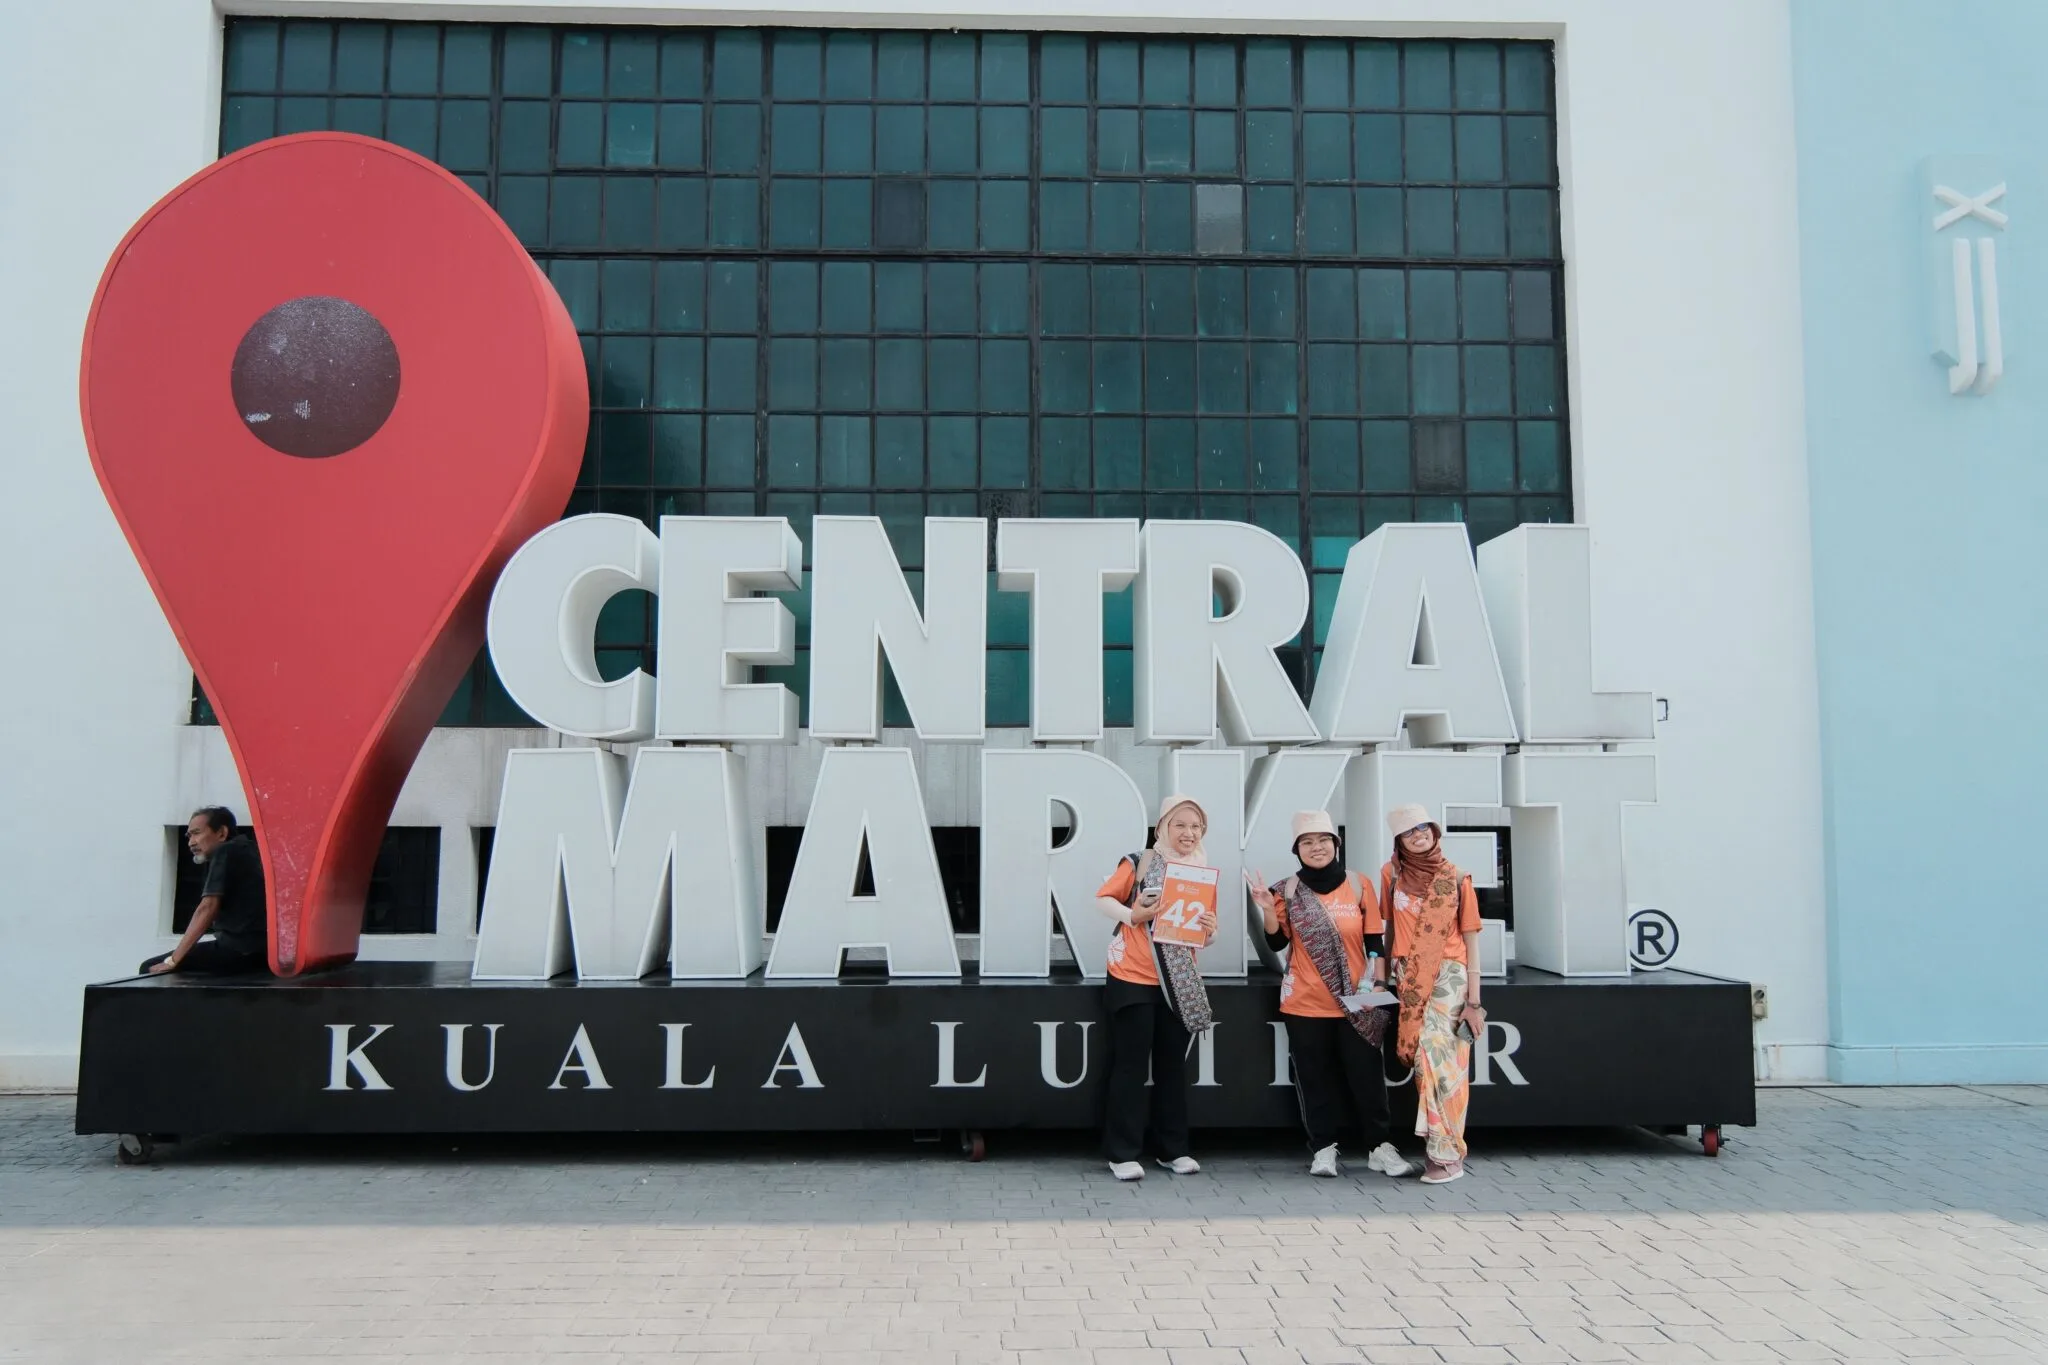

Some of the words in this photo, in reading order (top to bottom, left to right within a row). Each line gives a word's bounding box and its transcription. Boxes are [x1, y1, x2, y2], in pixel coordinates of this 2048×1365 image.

[487, 512, 1656, 744] CENTRAL
[471, 746, 1660, 981] MARKET
[1160, 898, 1206, 932] 42
[323, 1021, 825, 1092] KUALA
